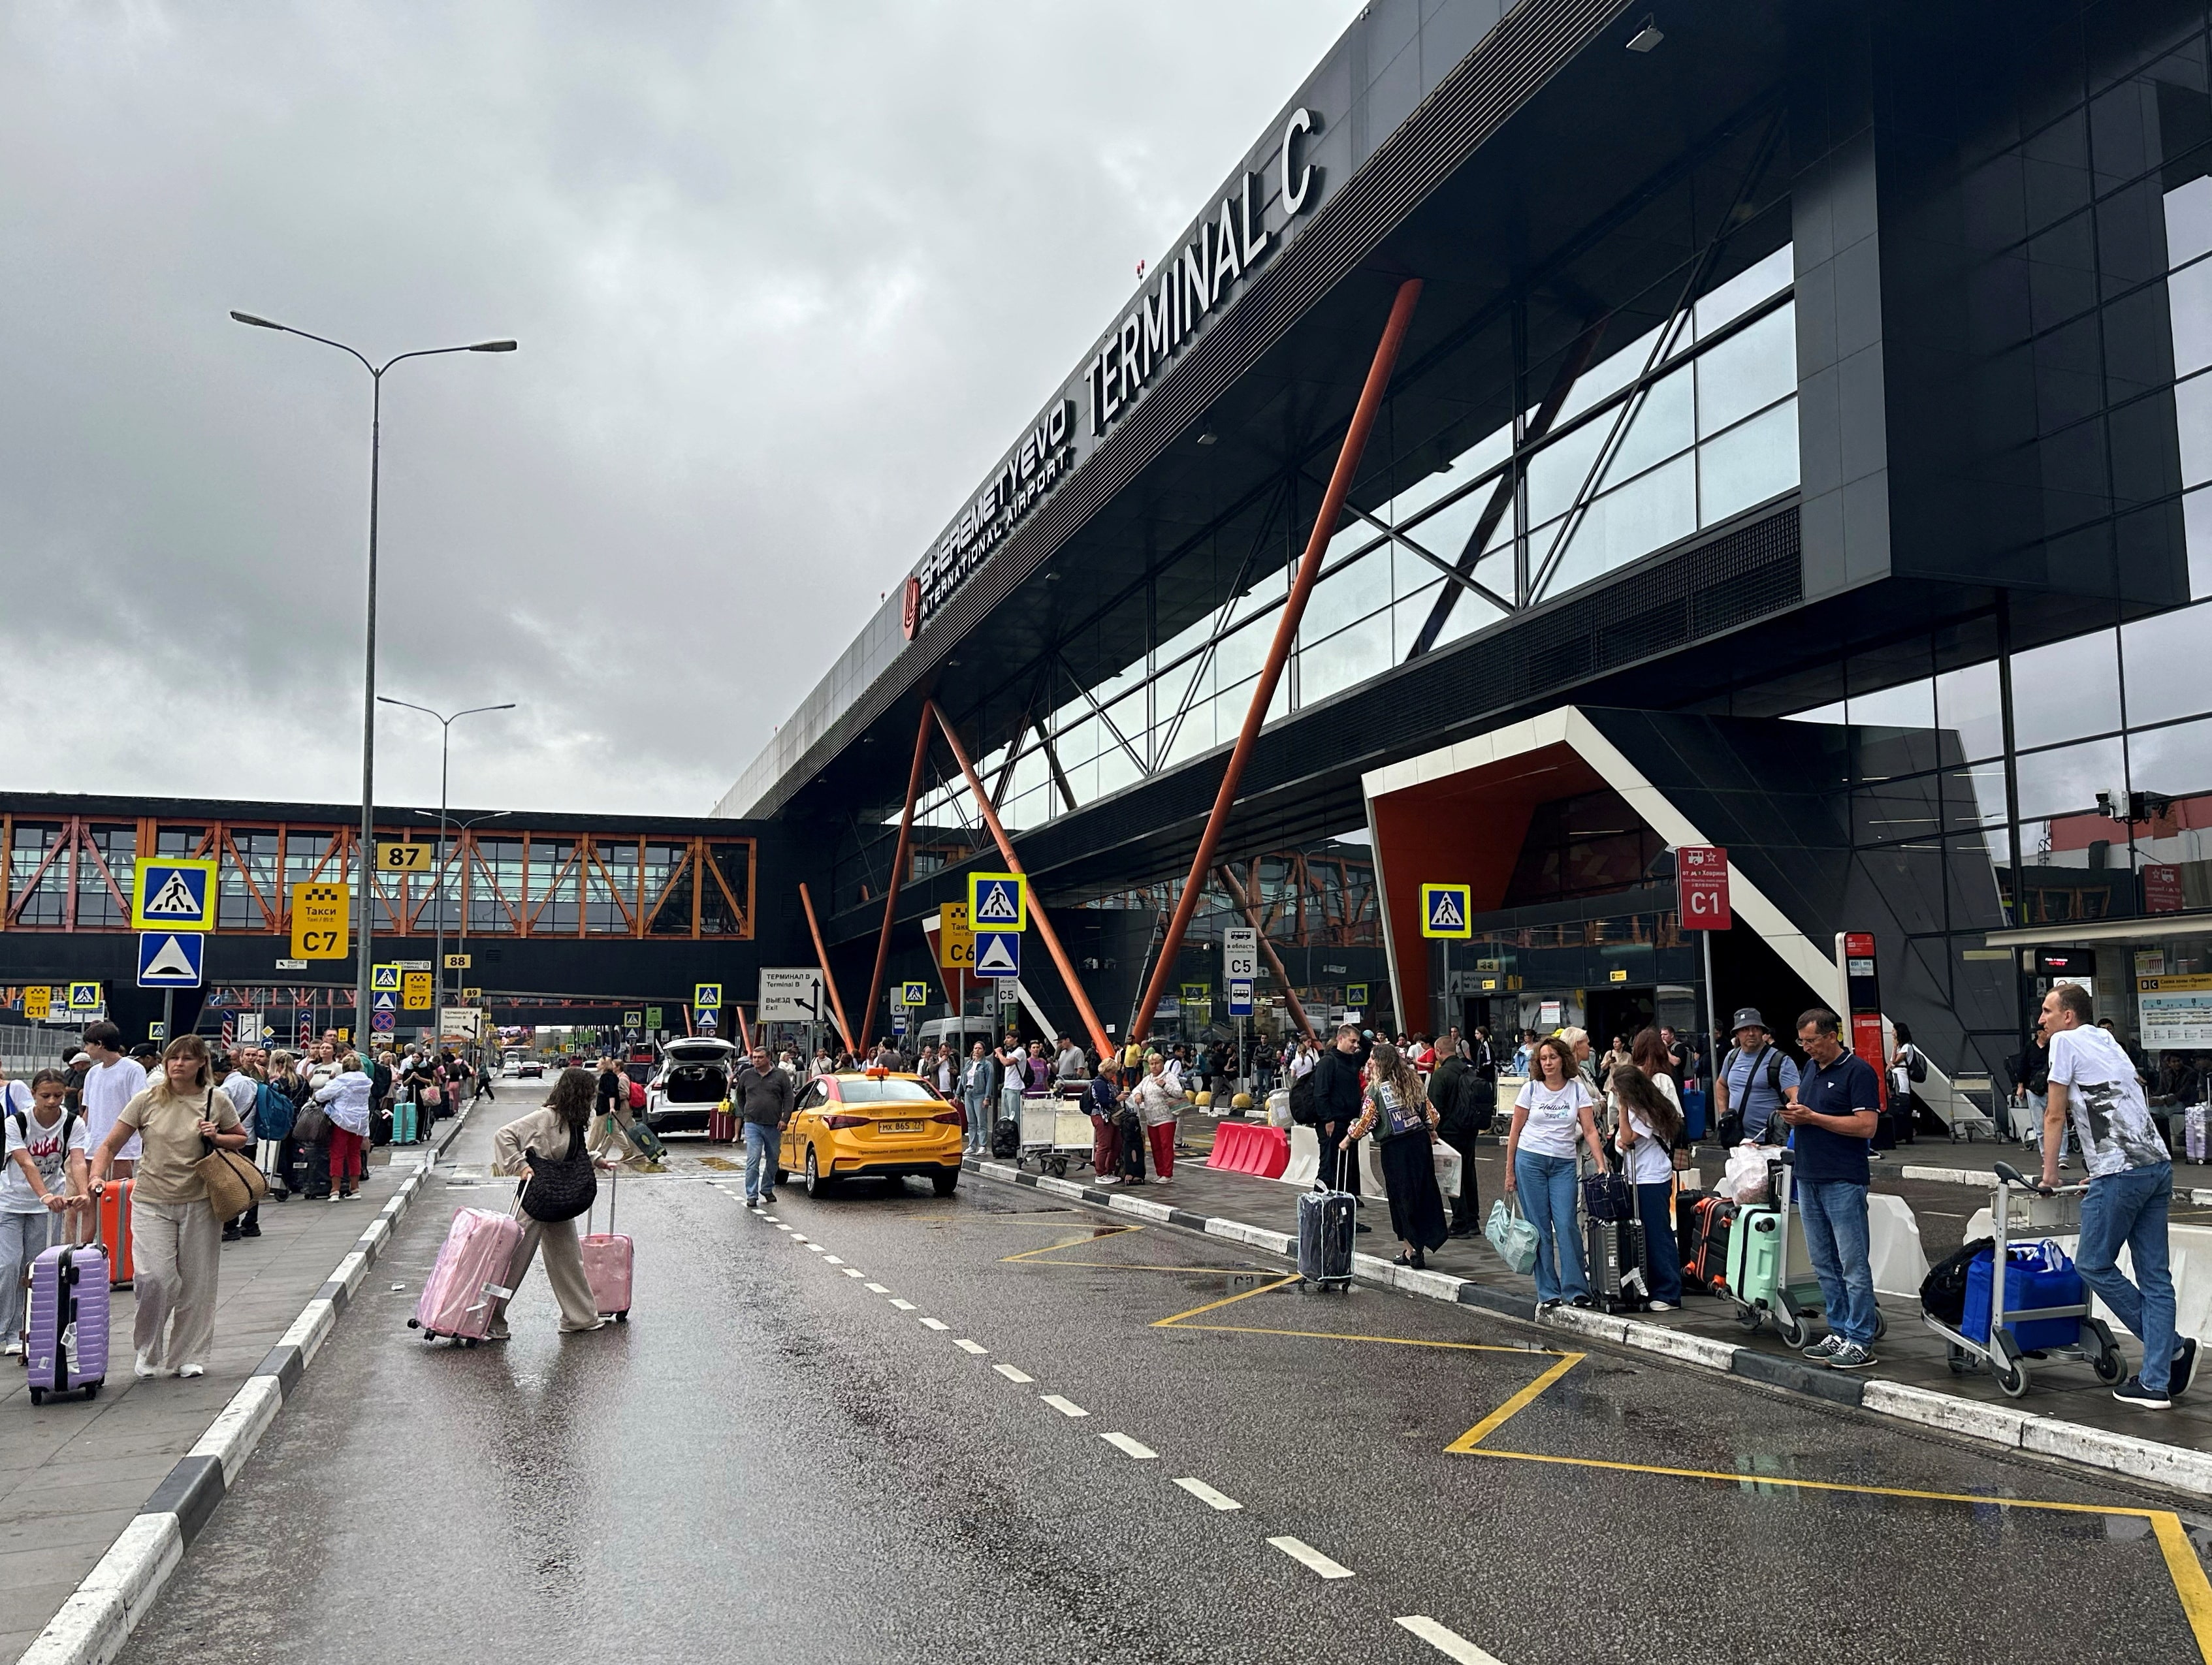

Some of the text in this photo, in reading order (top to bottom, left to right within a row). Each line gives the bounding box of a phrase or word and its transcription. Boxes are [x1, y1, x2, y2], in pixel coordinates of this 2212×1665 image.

[1084, 108, 1314, 437] TERMINAL C
[920, 398, 1066, 595] SHEREMETYEVO
[920, 445, 1066, 620] INTERNATIONAL AIRPORT
[388, 848, 420, 866] 87
[1691, 891, 1719, 914] C1
[306, 906, 336, 915] Такси
[303, 931, 338, 952] C7
[950, 944, 974, 961] C6
[450, 957, 466, 966] 88
[1231, 959, 1251, 973] C5
[409, 996, 426, 1006] C7
[999, 990, 1014, 1000] C5
[27, 1006, 46, 1015] C11
[895, 1122, 910, 1130] 865
